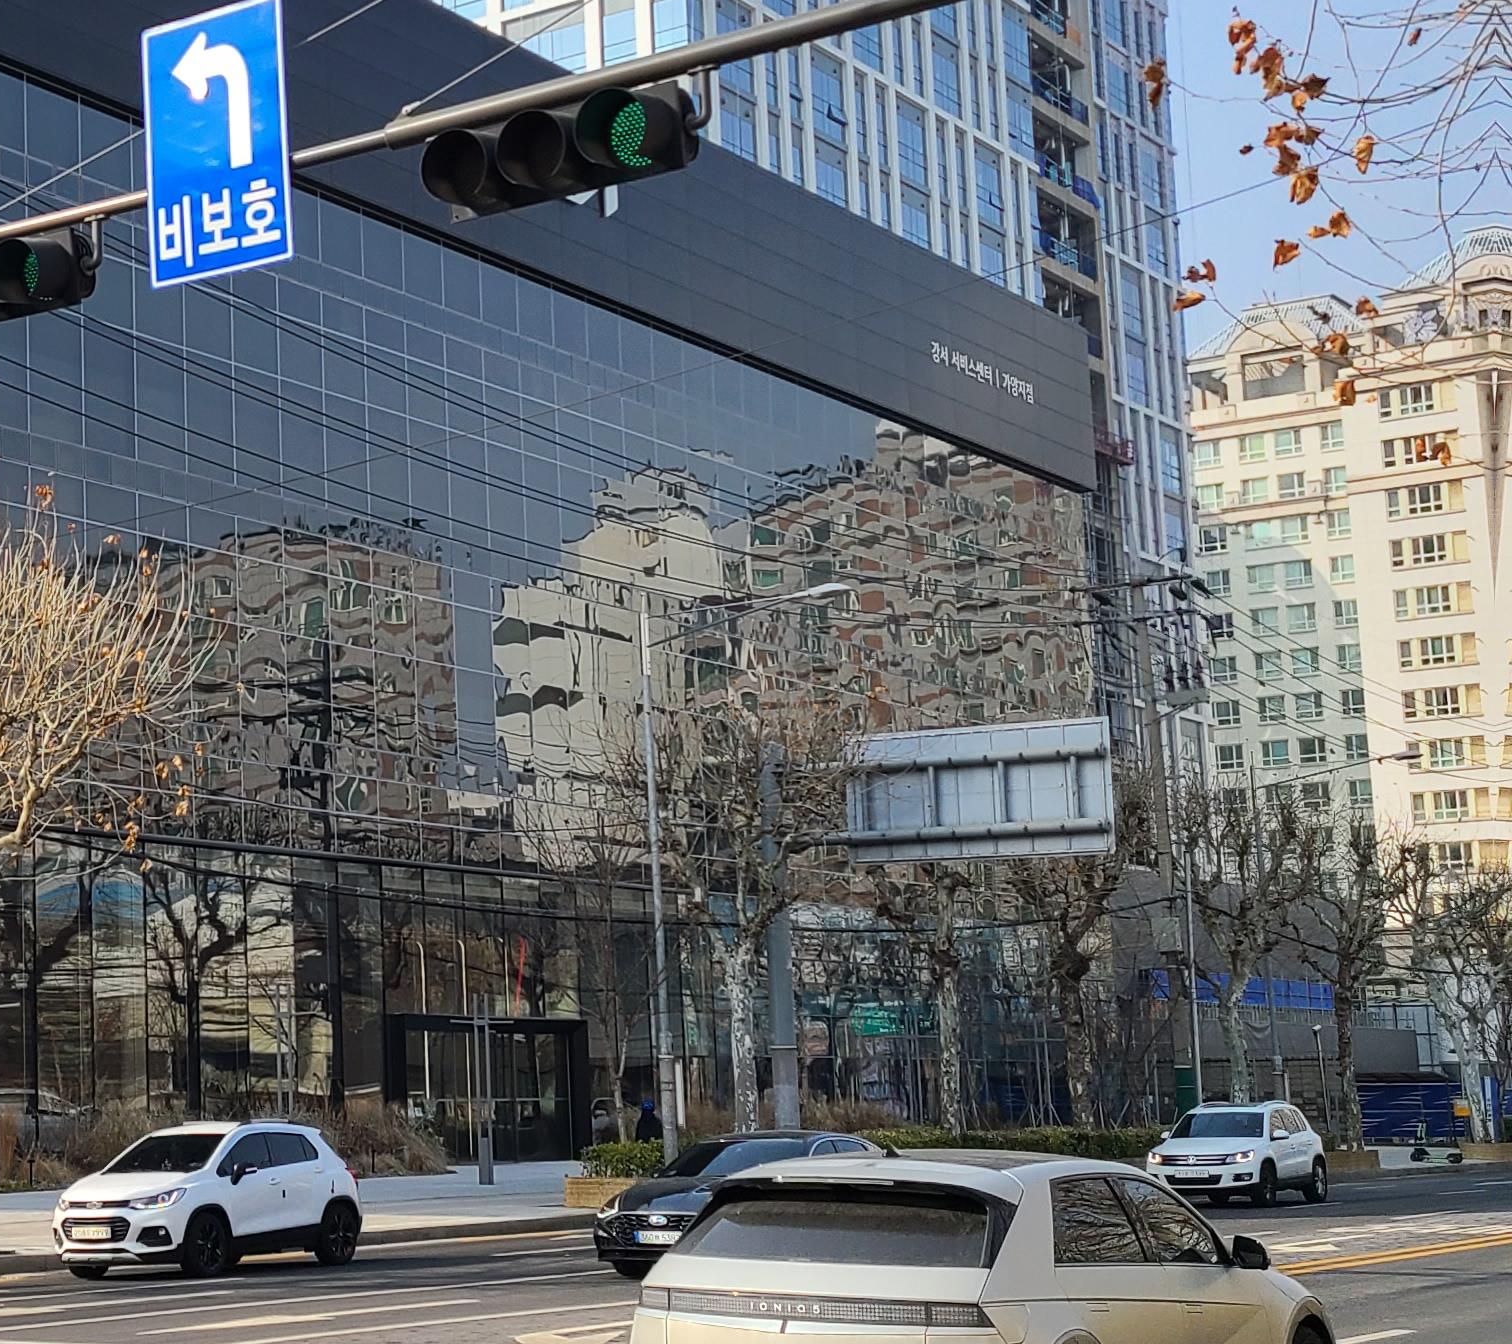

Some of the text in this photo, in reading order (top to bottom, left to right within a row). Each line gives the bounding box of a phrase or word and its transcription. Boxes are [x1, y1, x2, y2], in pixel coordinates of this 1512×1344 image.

[158, 178, 281, 268] 비보호
[931, 341, 949, 367] 강서
[951, 351, 993, 386] 서비스센터
[1002, 373, 1034, 405] 가양지점
